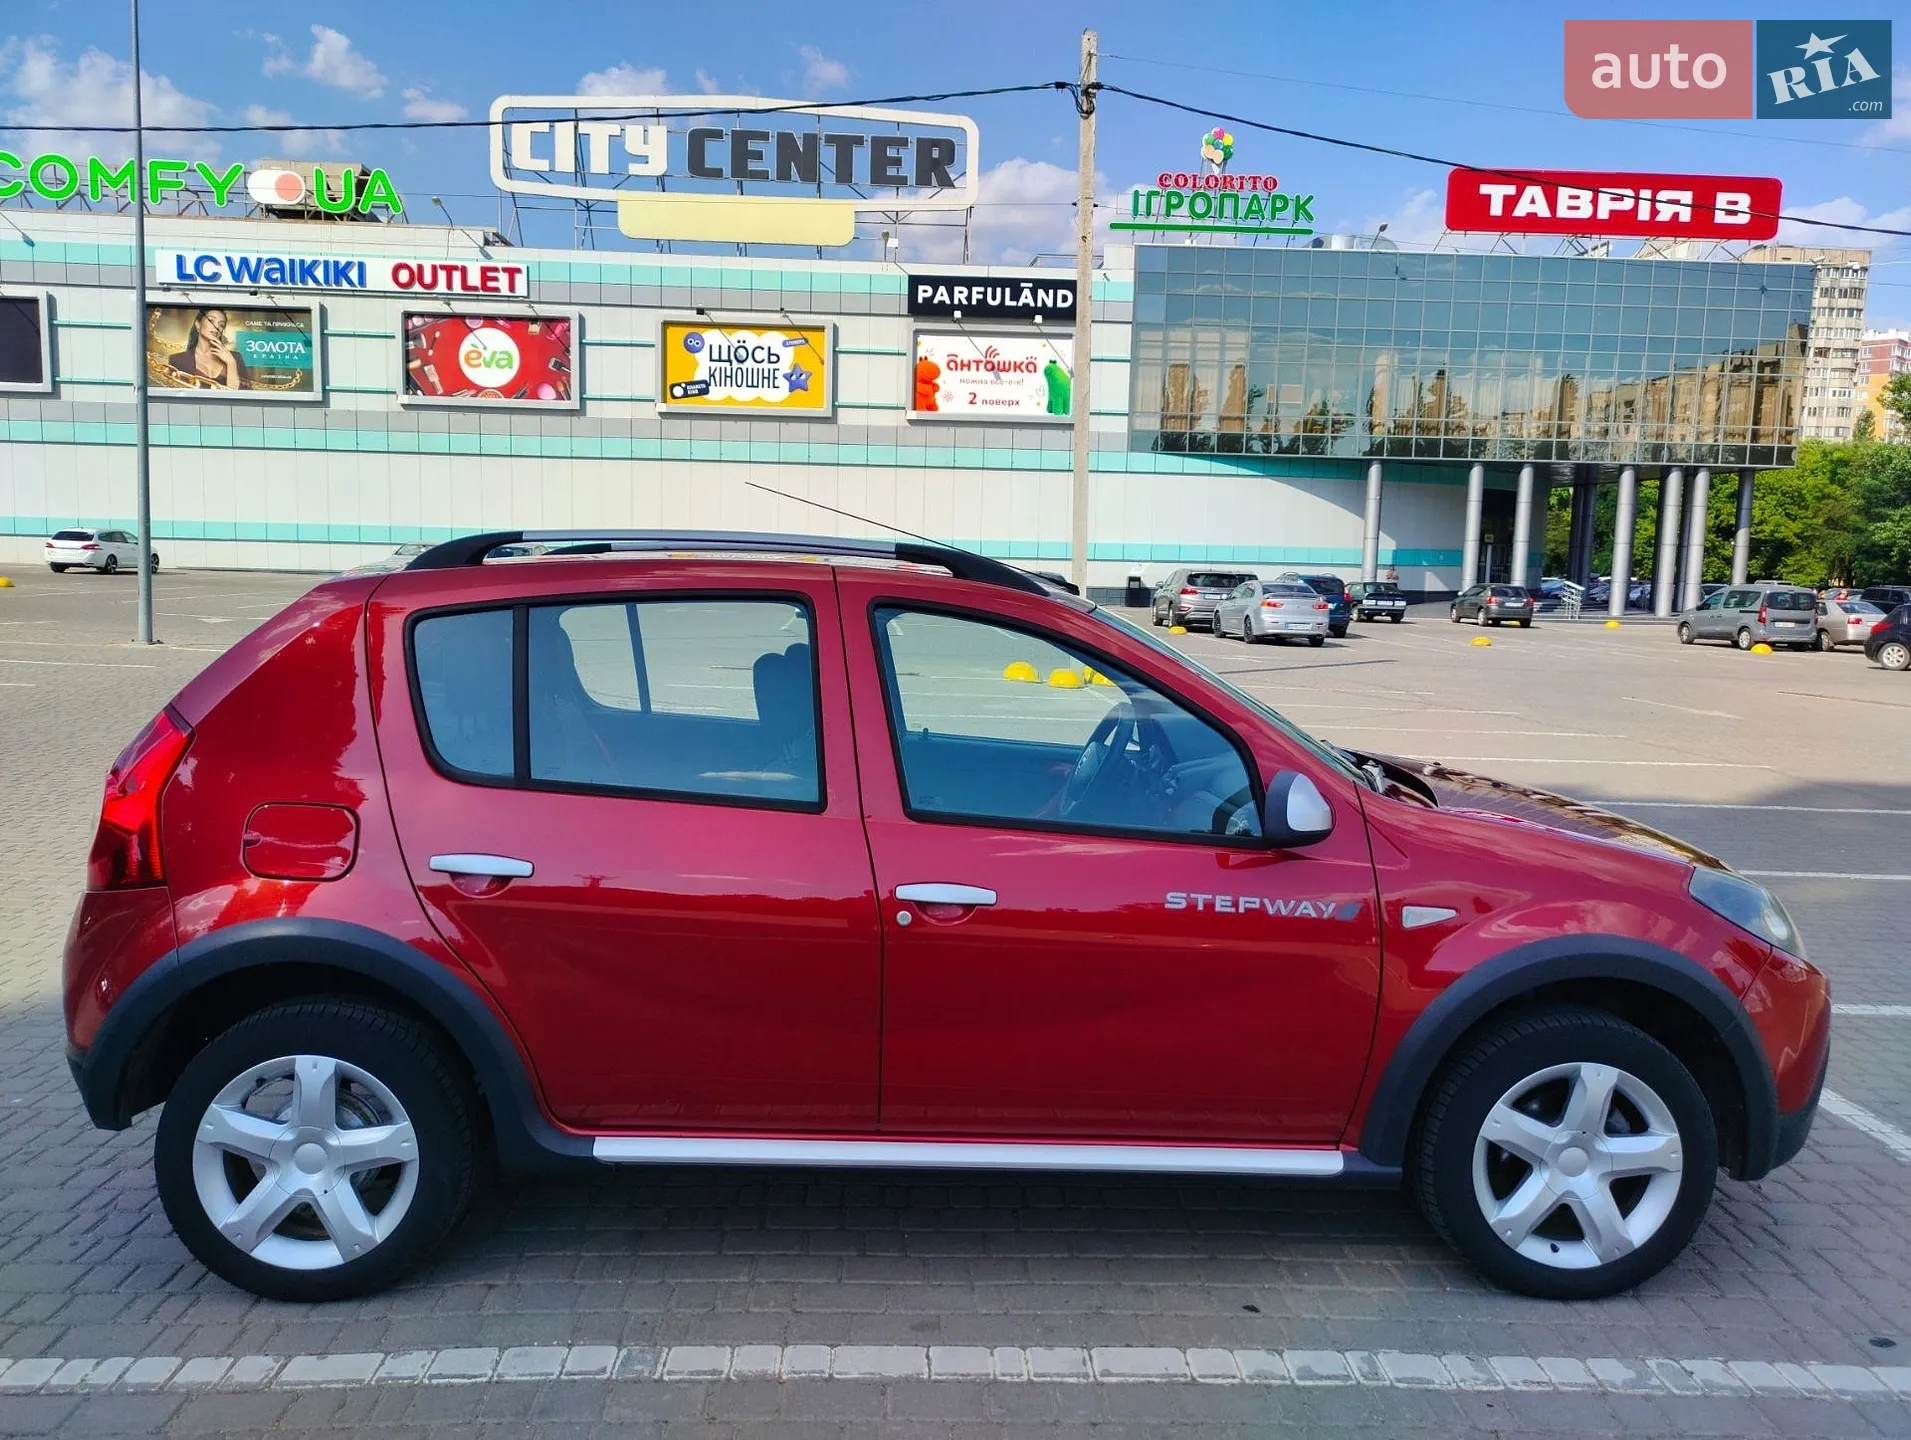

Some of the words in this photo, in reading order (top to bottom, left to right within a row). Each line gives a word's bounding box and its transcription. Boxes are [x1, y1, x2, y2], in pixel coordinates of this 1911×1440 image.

[511, 122, 668, 176] CITY
[687, 126, 958, 188] CENTER
[315, 165, 403, 216] UA
[1157, 172, 1279, 192] COLORITO
[1132, 189, 1315, 223] ІГРОПАРК
[1478, 183, 1693, 223] ТАВРІЯ
[1713, 191, 1752, 225] В
[175, 254, 221, 283] LC
[391, 262, 522, 293] OUTLET
[245, 340, 306, 354] ЗОЛОТА
[708, 365, 780, 389] КІНОШНЕ
[968, 392, 977, 405] 2
[981, 399, 1020, 408] поверх
[1164, 891, 1337, 919] STEPWAY
